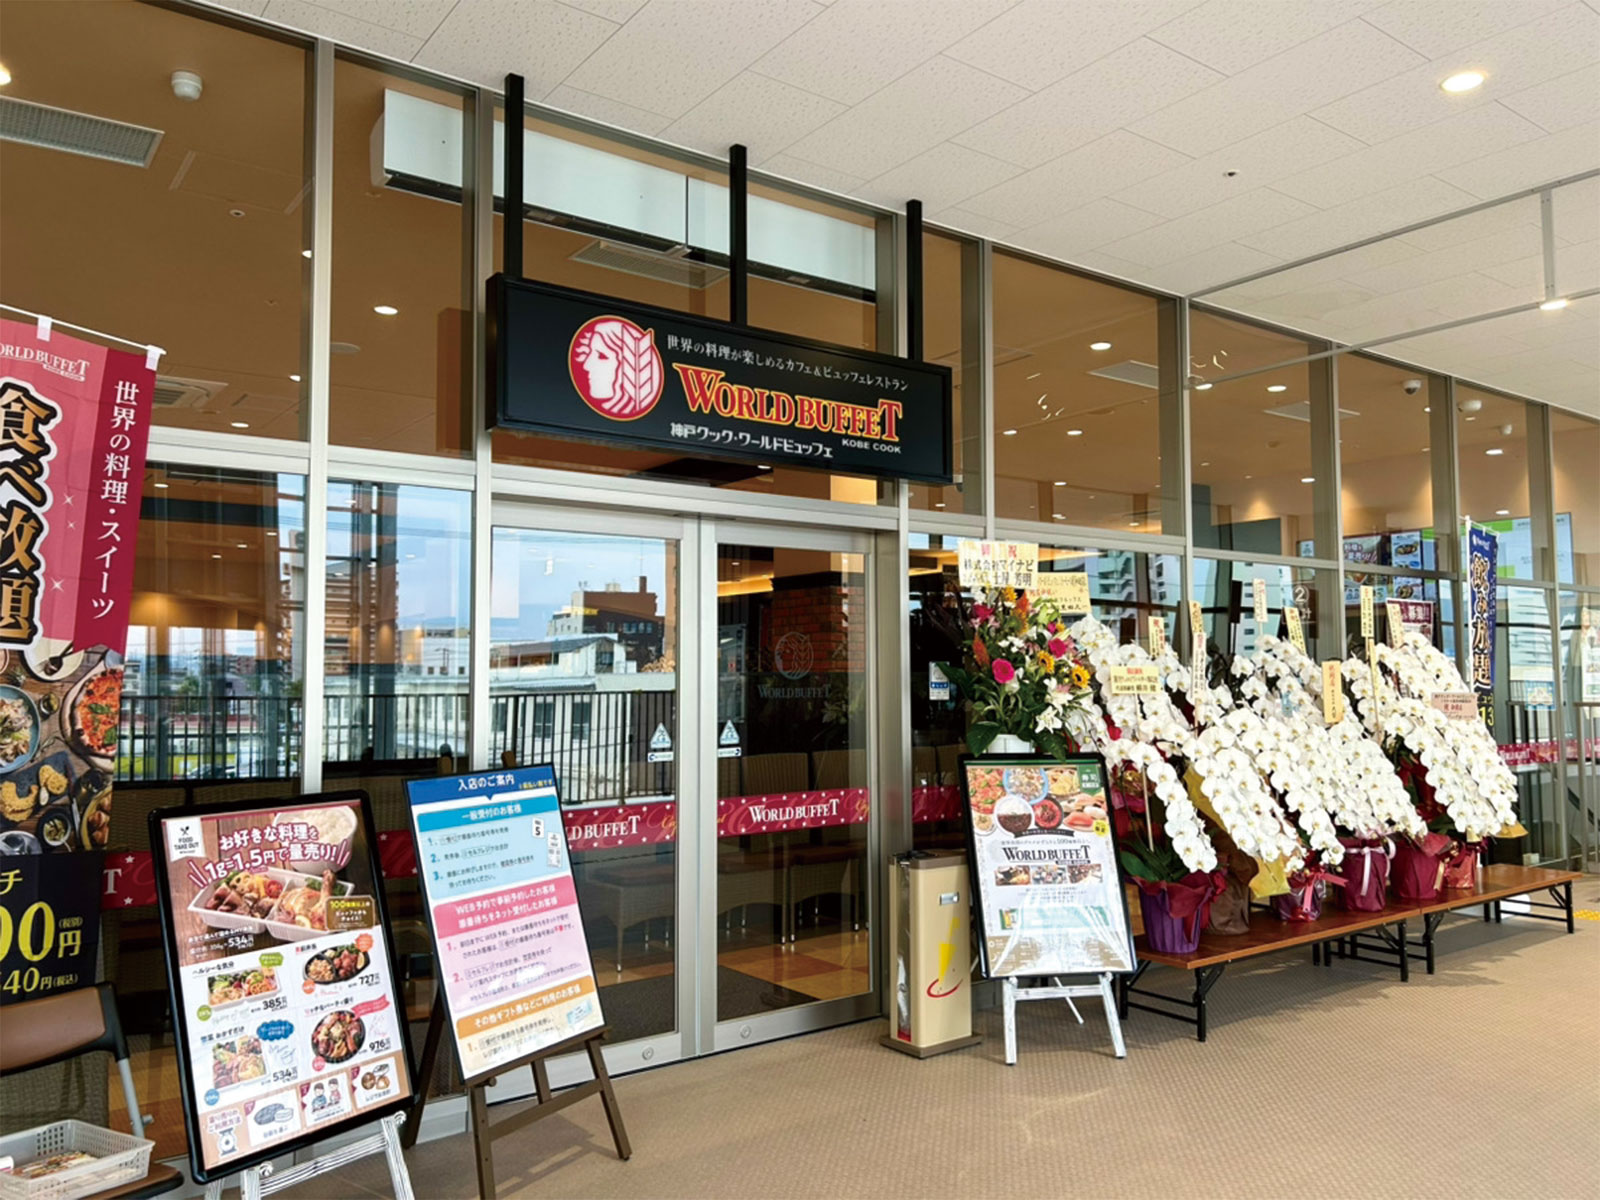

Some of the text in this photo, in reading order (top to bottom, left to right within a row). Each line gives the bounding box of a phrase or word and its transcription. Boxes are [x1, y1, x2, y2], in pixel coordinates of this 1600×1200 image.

[36, 349, 90, 376] BUFFET
[672, 363, 903, 441] WORLD BUFFET
[670, 422, 834, 458] 神戸クック・ワールドビュッフェ
[841, 438, 902, 454] KOBE COOK
[92, 380, 140, 620] 世界の料理・スイーツ
[757, 684, 831, 698] WORLD BUFFET
[456, 773, 515, 791] 入店のご案内
[460, 803, 522, 822] 一般受付のお客様
[748, 799, 840, 823] WORLD BUFFET
[219, 823, 319, 851] お好きな料理を
[583, 815, 641, 839] BUFFET
[1003, 845, 1091, 861] WORLD BUFFET
